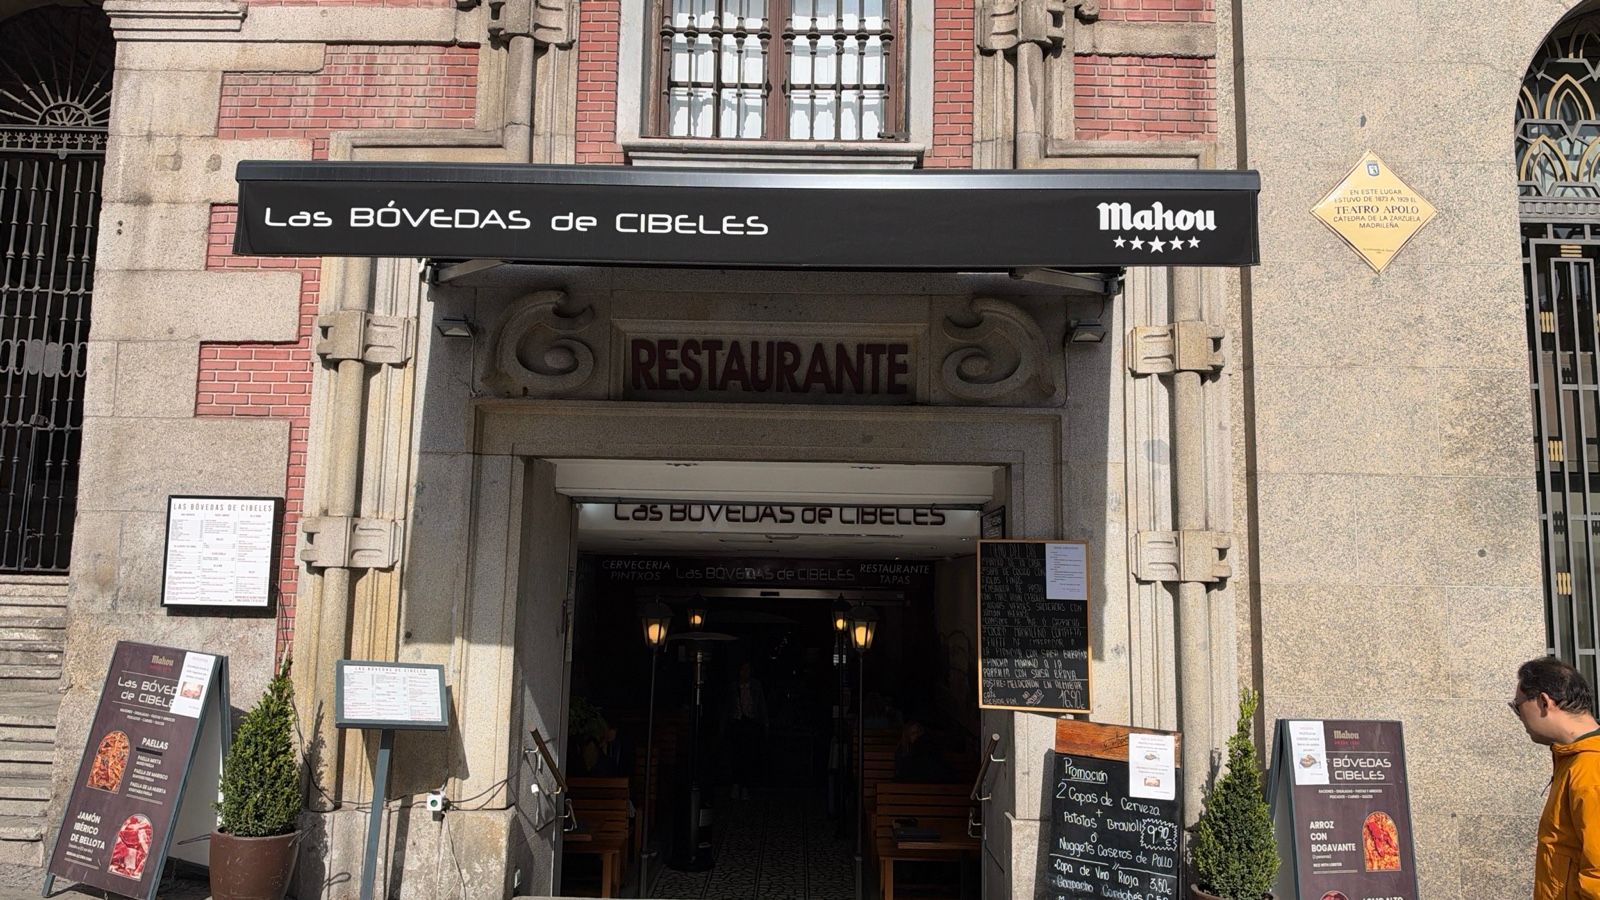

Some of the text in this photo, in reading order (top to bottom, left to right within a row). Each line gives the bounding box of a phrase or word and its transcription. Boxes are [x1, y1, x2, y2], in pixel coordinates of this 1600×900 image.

[1096, 201, 1218, 231] Mahou
[1334, 205, 1420, 215] TEATRO APOLO
[264, 200, 770, 236] Las BÓVEDAS de CIBELES
[1389, 215, 1421, 223] ZARZUELA
[630, 338, 909, 394] RESTAURANTE
[173, 503, 187, 511] LAS
[227, 504, 237, 512] DE
[240, 504, 272, 512] CIBELES
[800, 506, 834, 525] de
[609, 570, 662, 582] PINTXOS
[675, 567, 704, 580] Las
[776, 566, 796, 581] de
[797, 567, 857, 583] CIBELES
[879, 573, 912, 586] TAPAS
[859, 562, 930, 576] RESTAURANTE
[151, 654, 175, 667] Mahou
[1014, 668, 1028, 679] CON
[117, 676, 138, 688] Las
[121, 690, 136, 701] de
[1333, 730, 1360, 740] Mahou
[141, 737, 169, 750] PAELLAS
[1333, 755, 1393, 769] BÓVEDAS
[1063, 757, 1108, 783] Promoción
[1334, 770, 1386, 781] CIBELES
[1056, 782, 1161, 816] 2 Copas de Cerveza
[77, 811, 102, 824] JAMÓN
[1064, 811, 1098, 828] Patatas
[73, 821, 99, 836] IBÉRICO
[1309, 820, 1335, 830] ARROZ
[70, 833, 81, 843] DE
[79, 834, 107, 850] BELLOTA
[1310, 832, 1328, 841] CON
[1059, 837, 1095, 857] Nuggets
[1097, 844, 1133, 860] Caseros
[1135, 850, 1148, 864] de
[1311, 843, 1357, 853] BOGAVANTE
[1080, 863, 1091, 877] de
[1095, 867, 1110, 881] Vino
[1118, 870, 1139, 889] Rioja
[1057, 874, 1094, 893] Gazpacho
